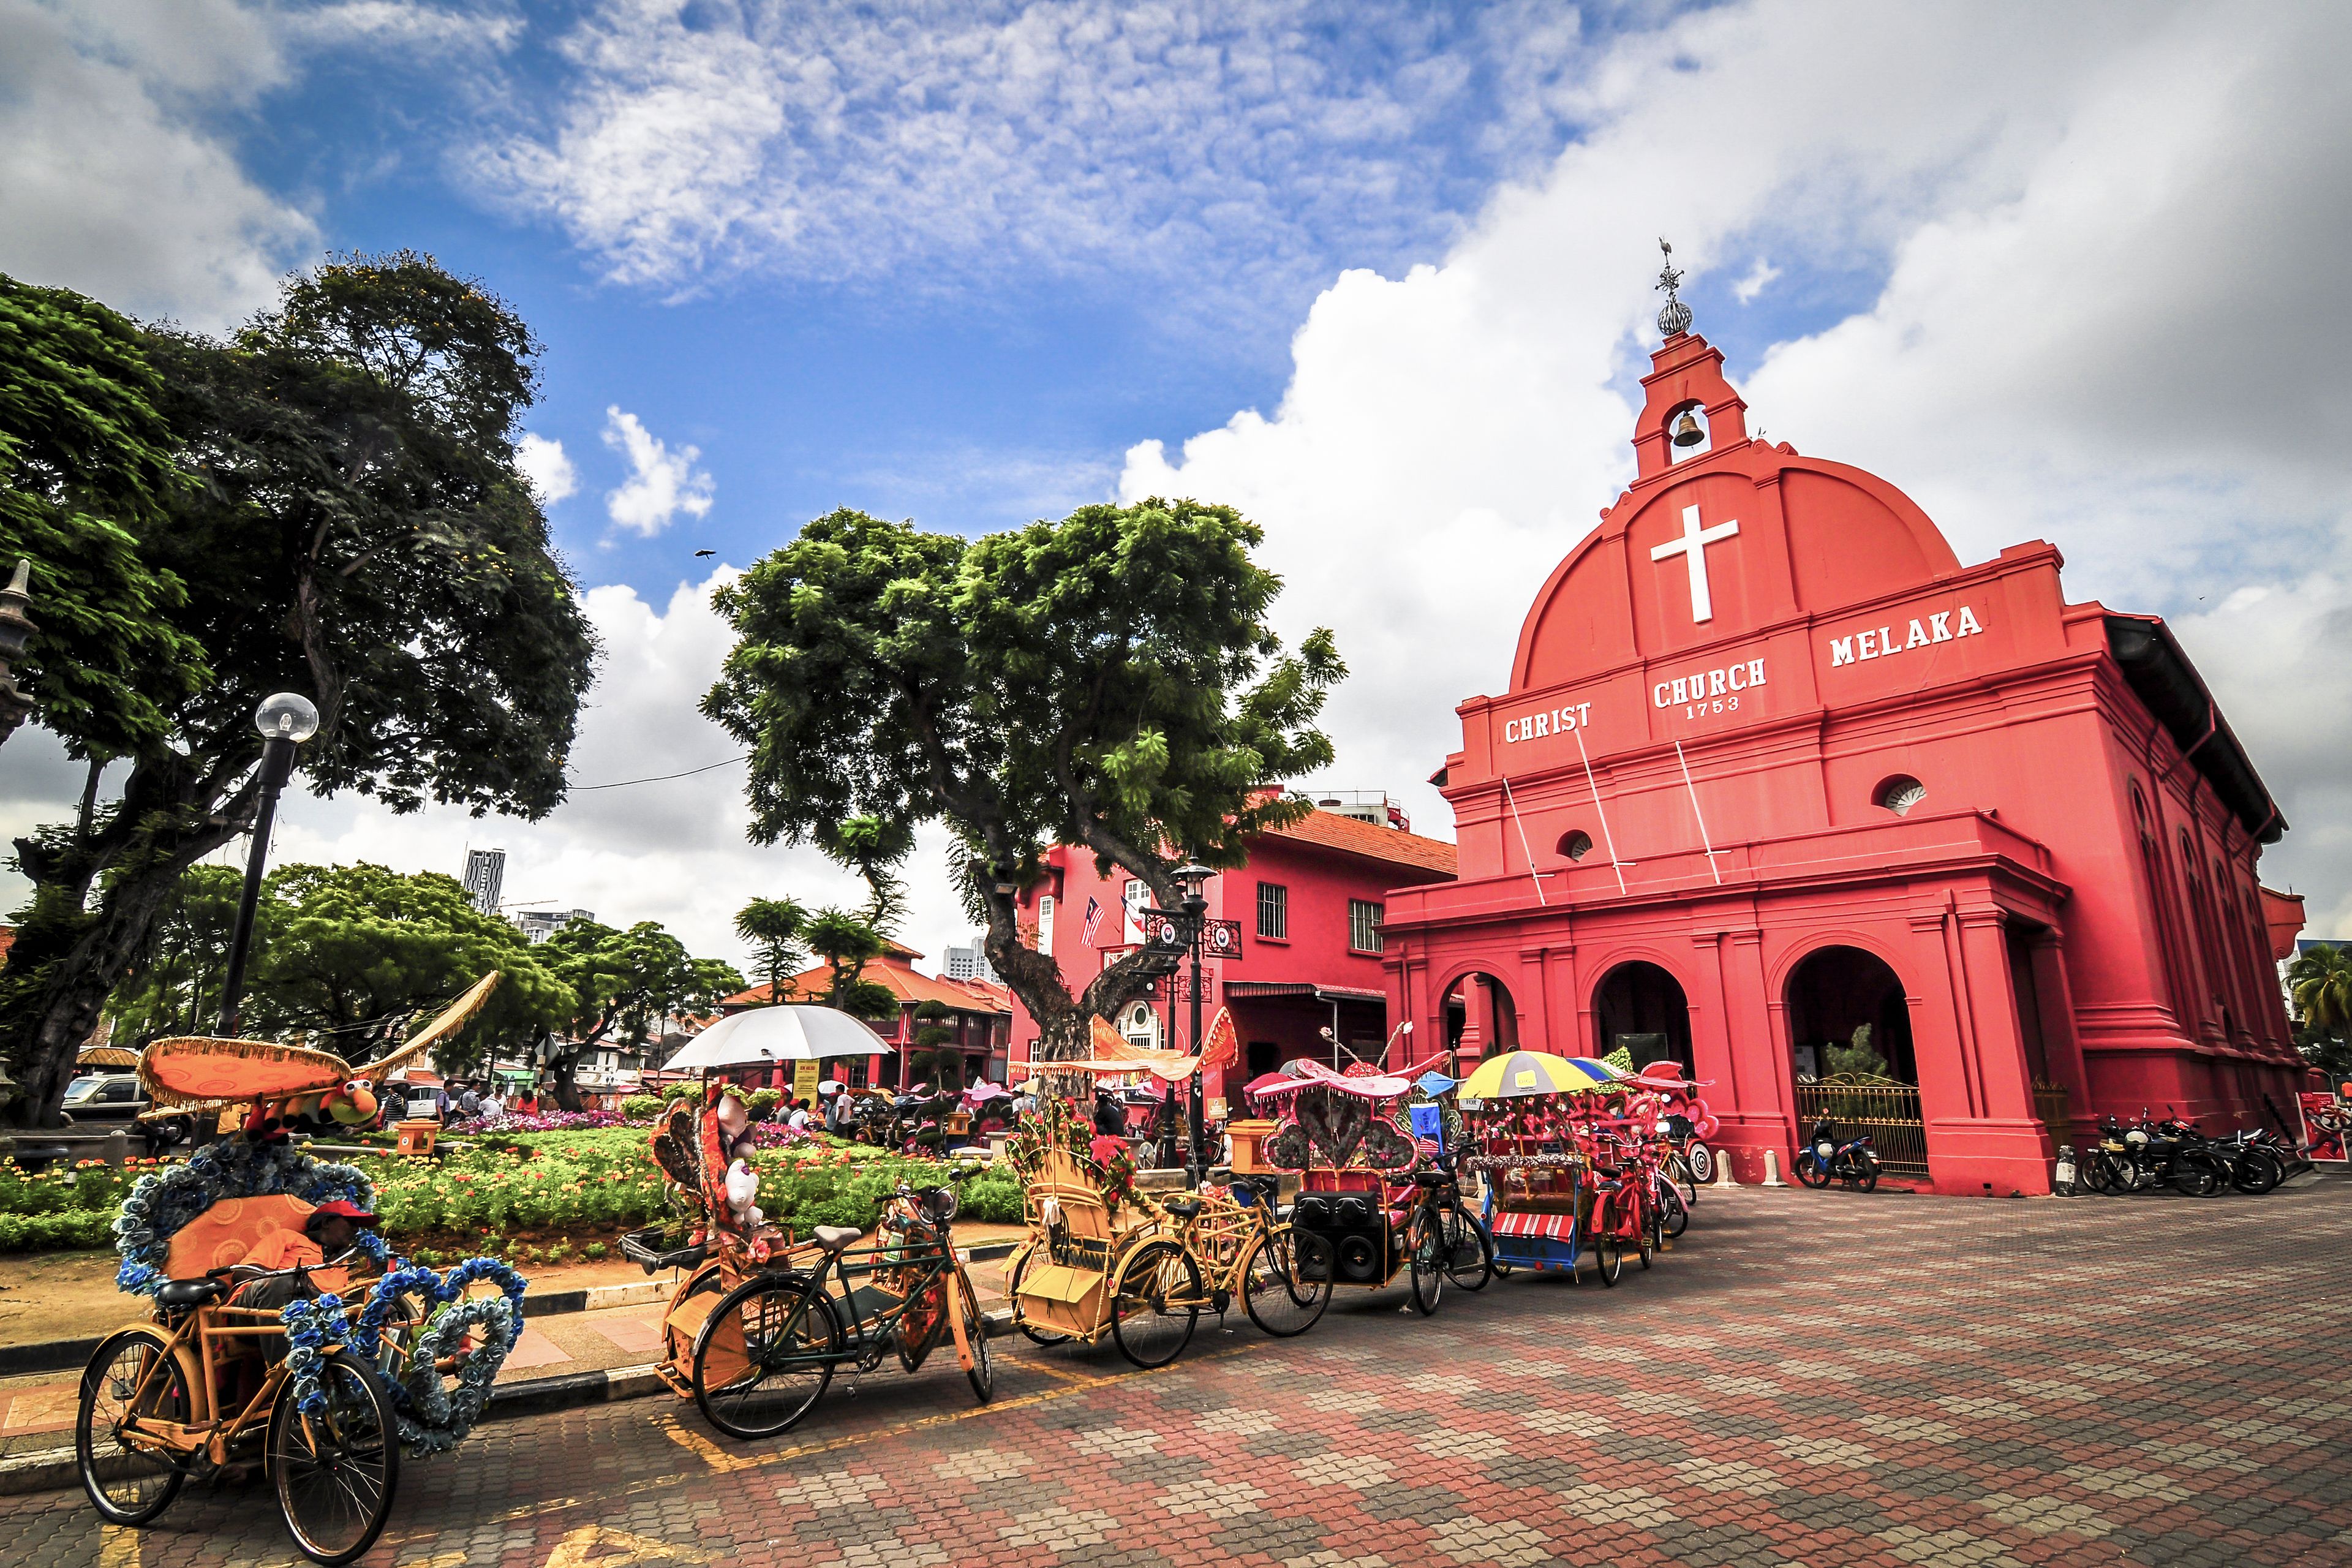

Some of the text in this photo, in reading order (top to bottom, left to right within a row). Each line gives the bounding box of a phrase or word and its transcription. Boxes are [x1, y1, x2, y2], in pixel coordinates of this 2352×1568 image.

[1505, 605, 1983, 743] CHRIST CHURCH MELAKA
[1686, 696, 1739, 720] 1753
